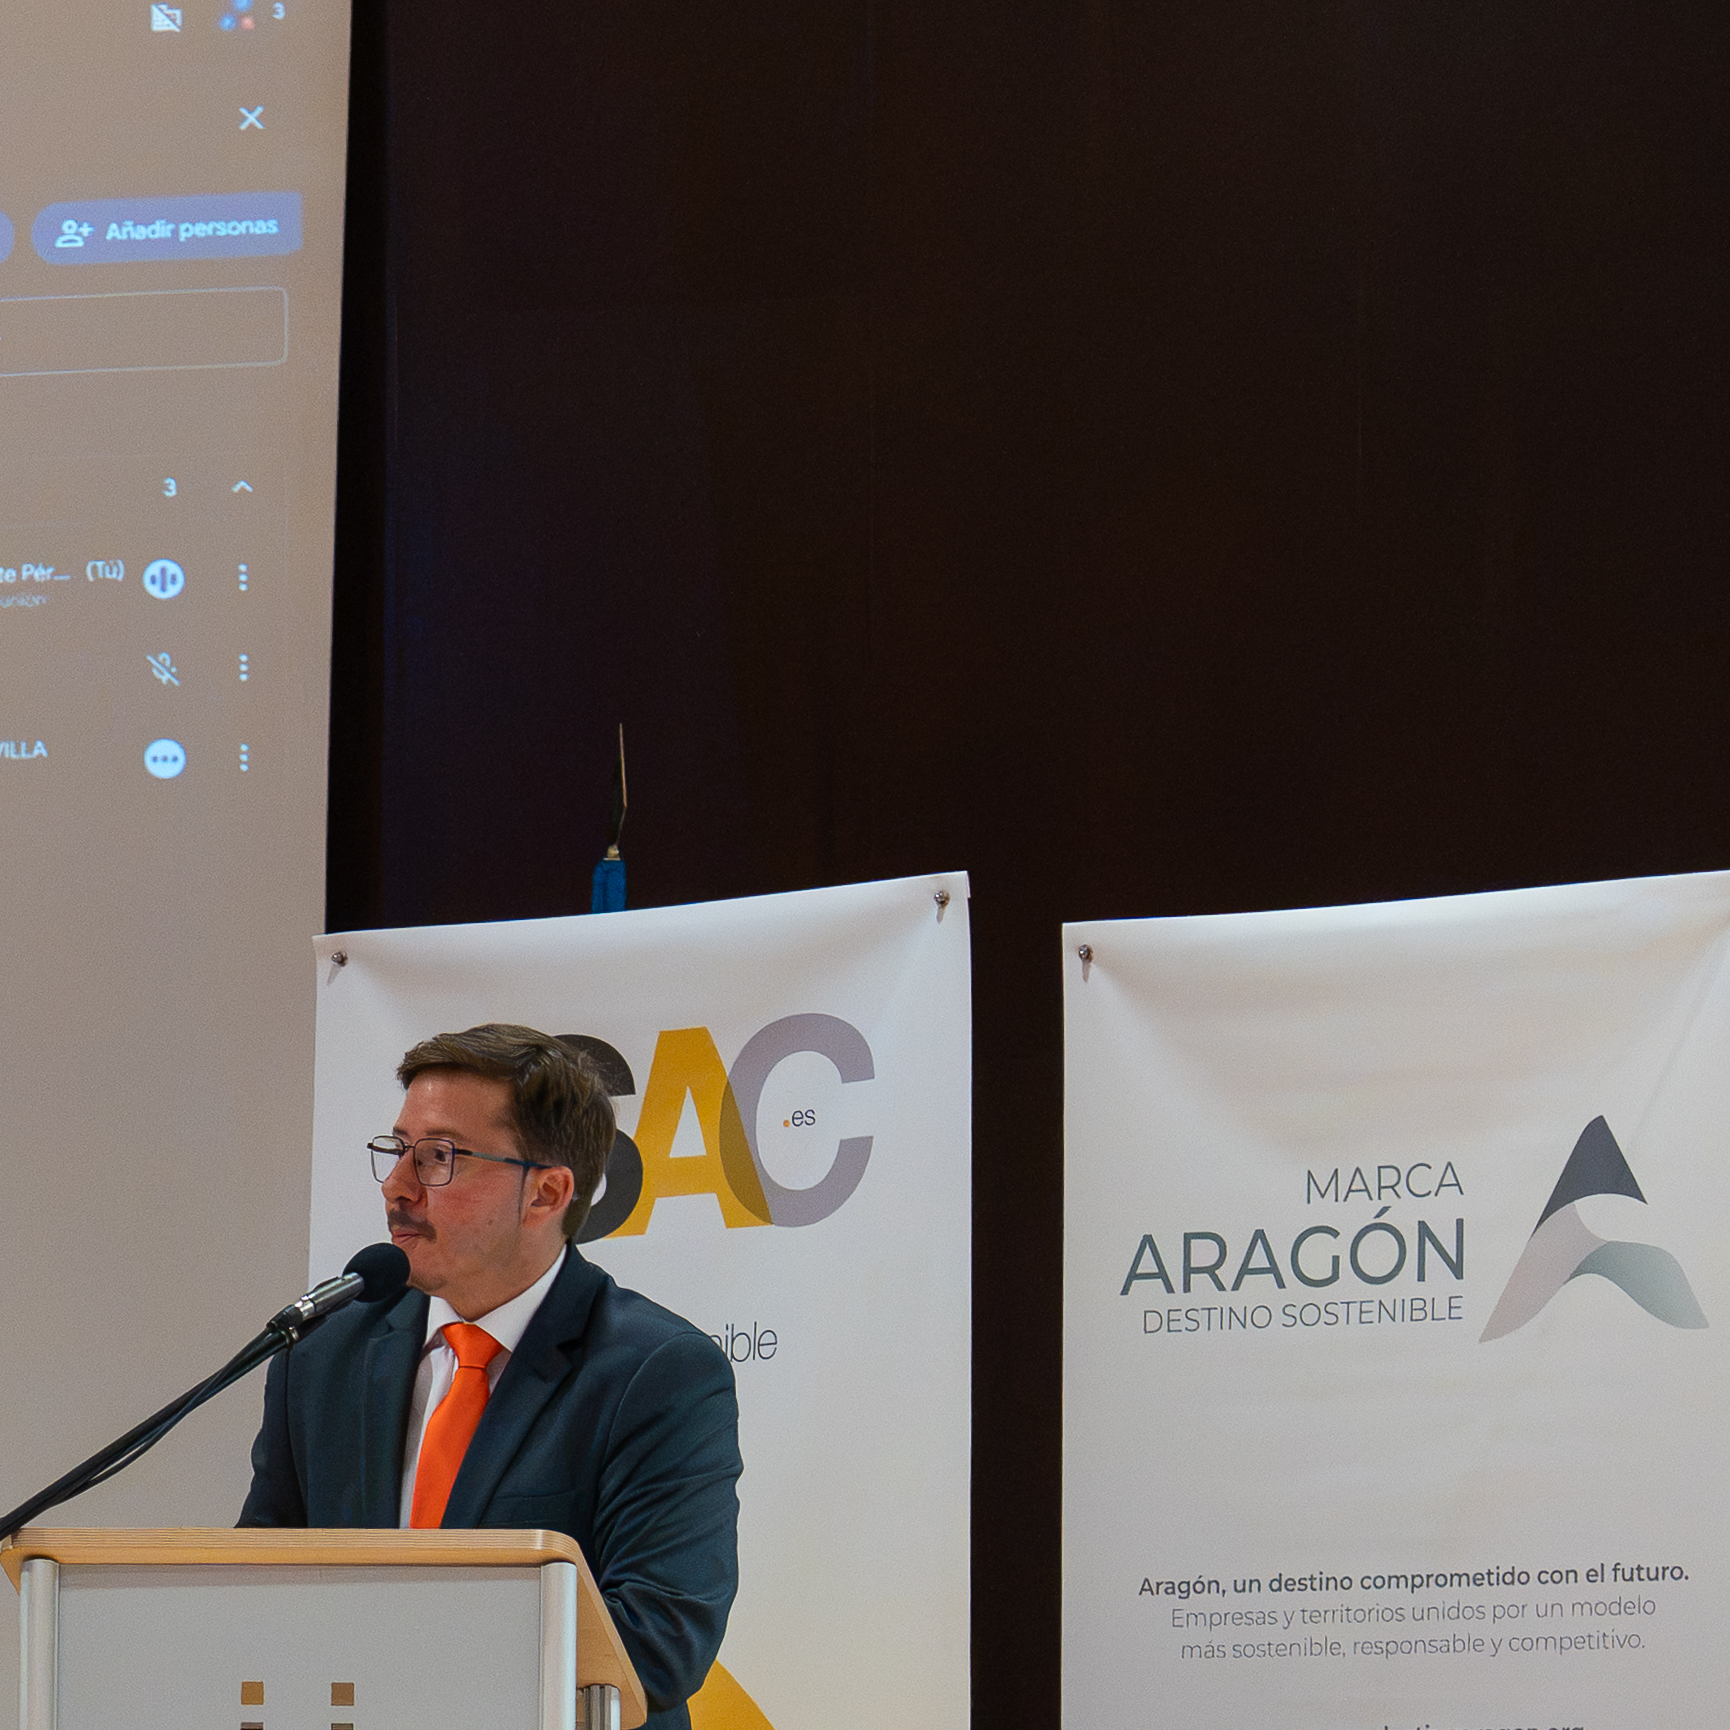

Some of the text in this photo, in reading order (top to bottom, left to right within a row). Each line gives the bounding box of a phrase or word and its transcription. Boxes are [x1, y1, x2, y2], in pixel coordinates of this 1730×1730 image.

[272, 2, 286, 20] 3
[105, 217, 279, 244] Añadir personas
[162, 477, 178, 498] 3
[1306, 1160, 1465, 1205] MARCA
[1119, 1205, 1464, 1297] ARAGÓN
[1142, 1295, 1464, 1335] DESTINO SOSTENIBLE
[1138, 1562, 1690, 1599] Aragón, un destino comprometido con el futuro.
[1171, 1595, 1657, 1632] Empresas y territorios unidos por un modelo
[1180, 1629, 1646, 1660] más sostenible, responsable y competitivo.
